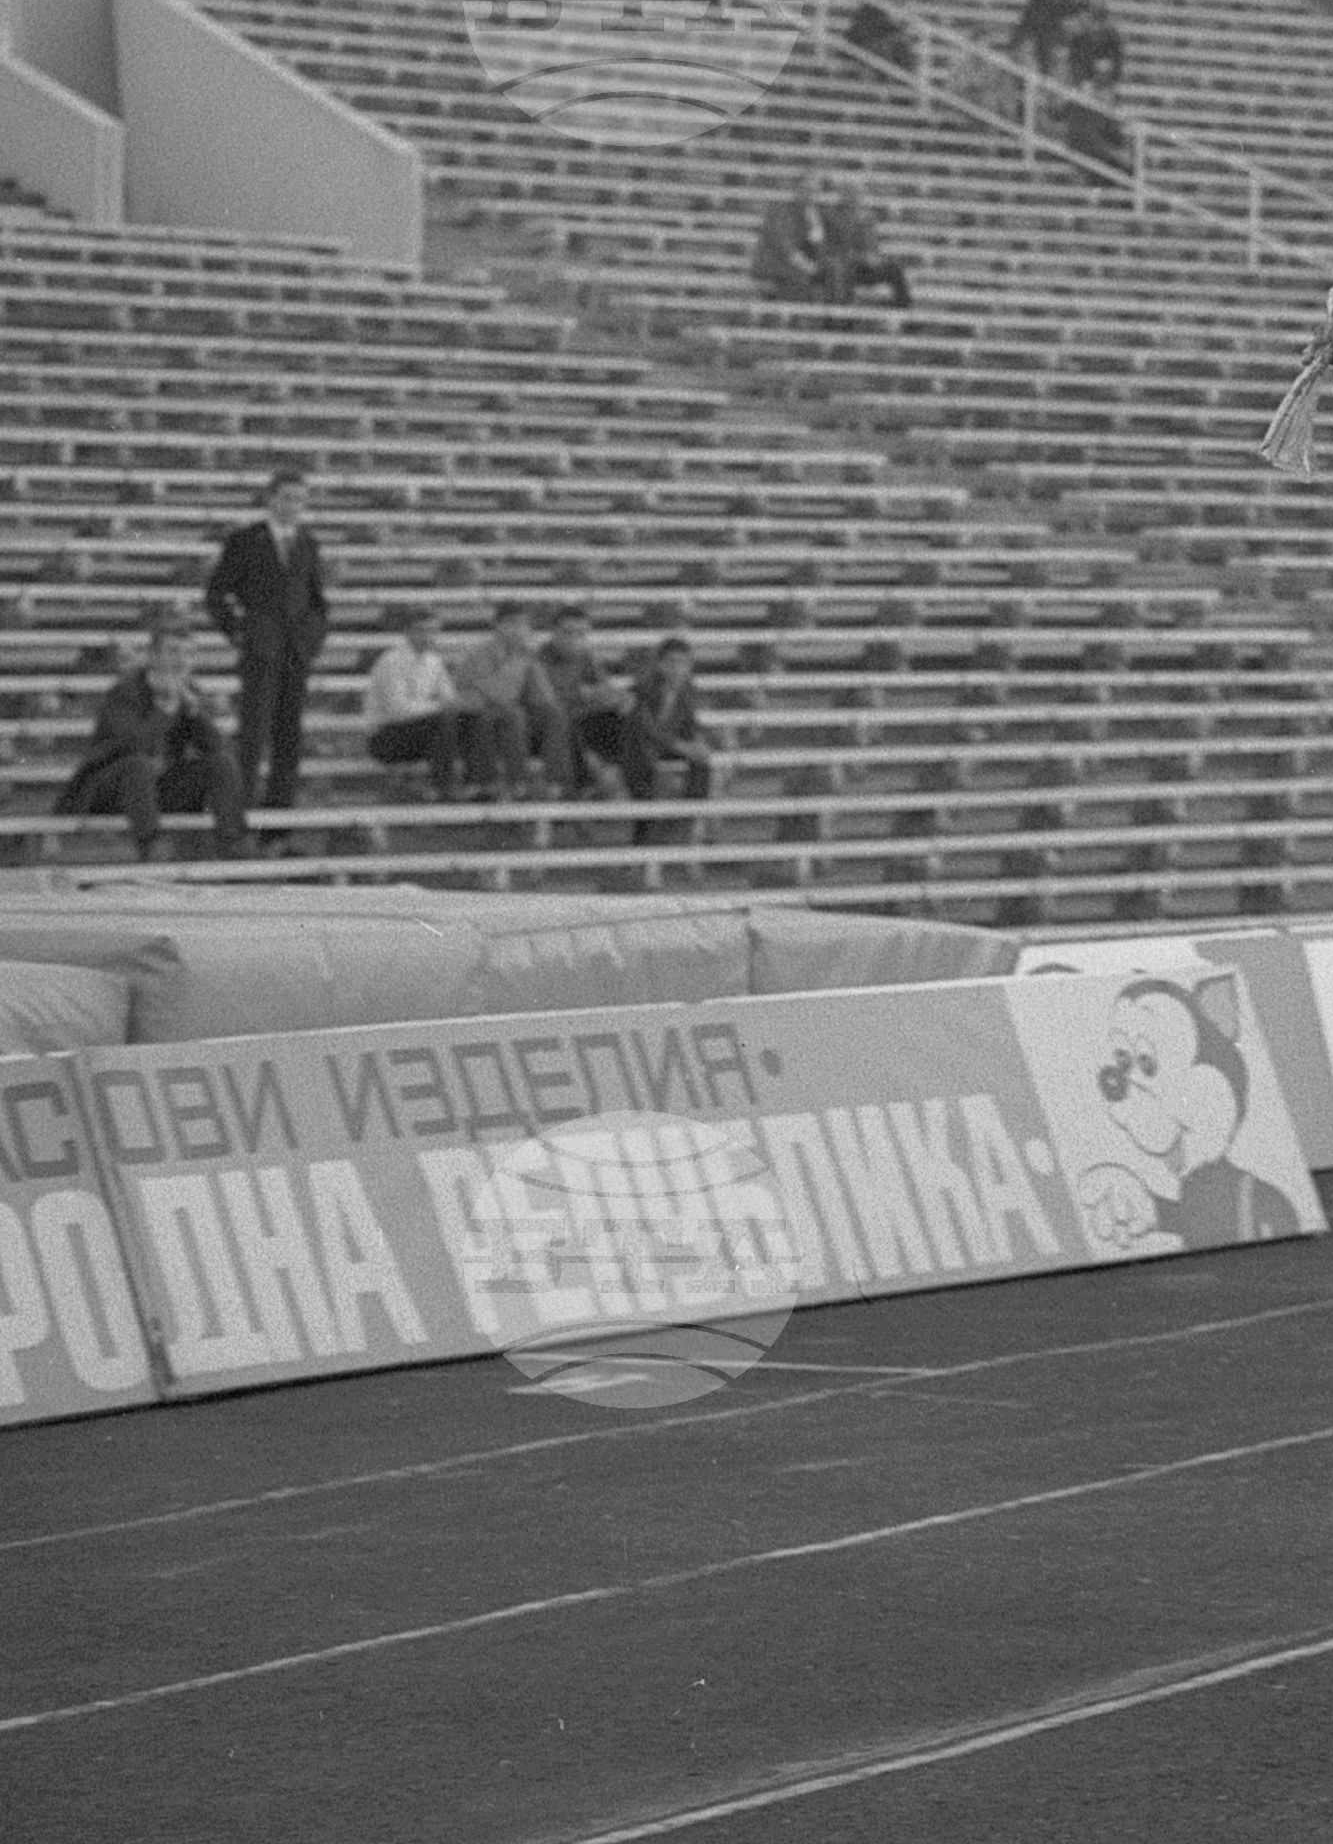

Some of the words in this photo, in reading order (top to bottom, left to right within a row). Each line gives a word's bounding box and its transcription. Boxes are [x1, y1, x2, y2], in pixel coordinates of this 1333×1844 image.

[0, 1060, 299, 1183] СОВИ
[326, 1022, 757, 1144] ИЗДЕЛИЯ
[418, 1093, 1062, 1336] РЕПУБЛИКА
